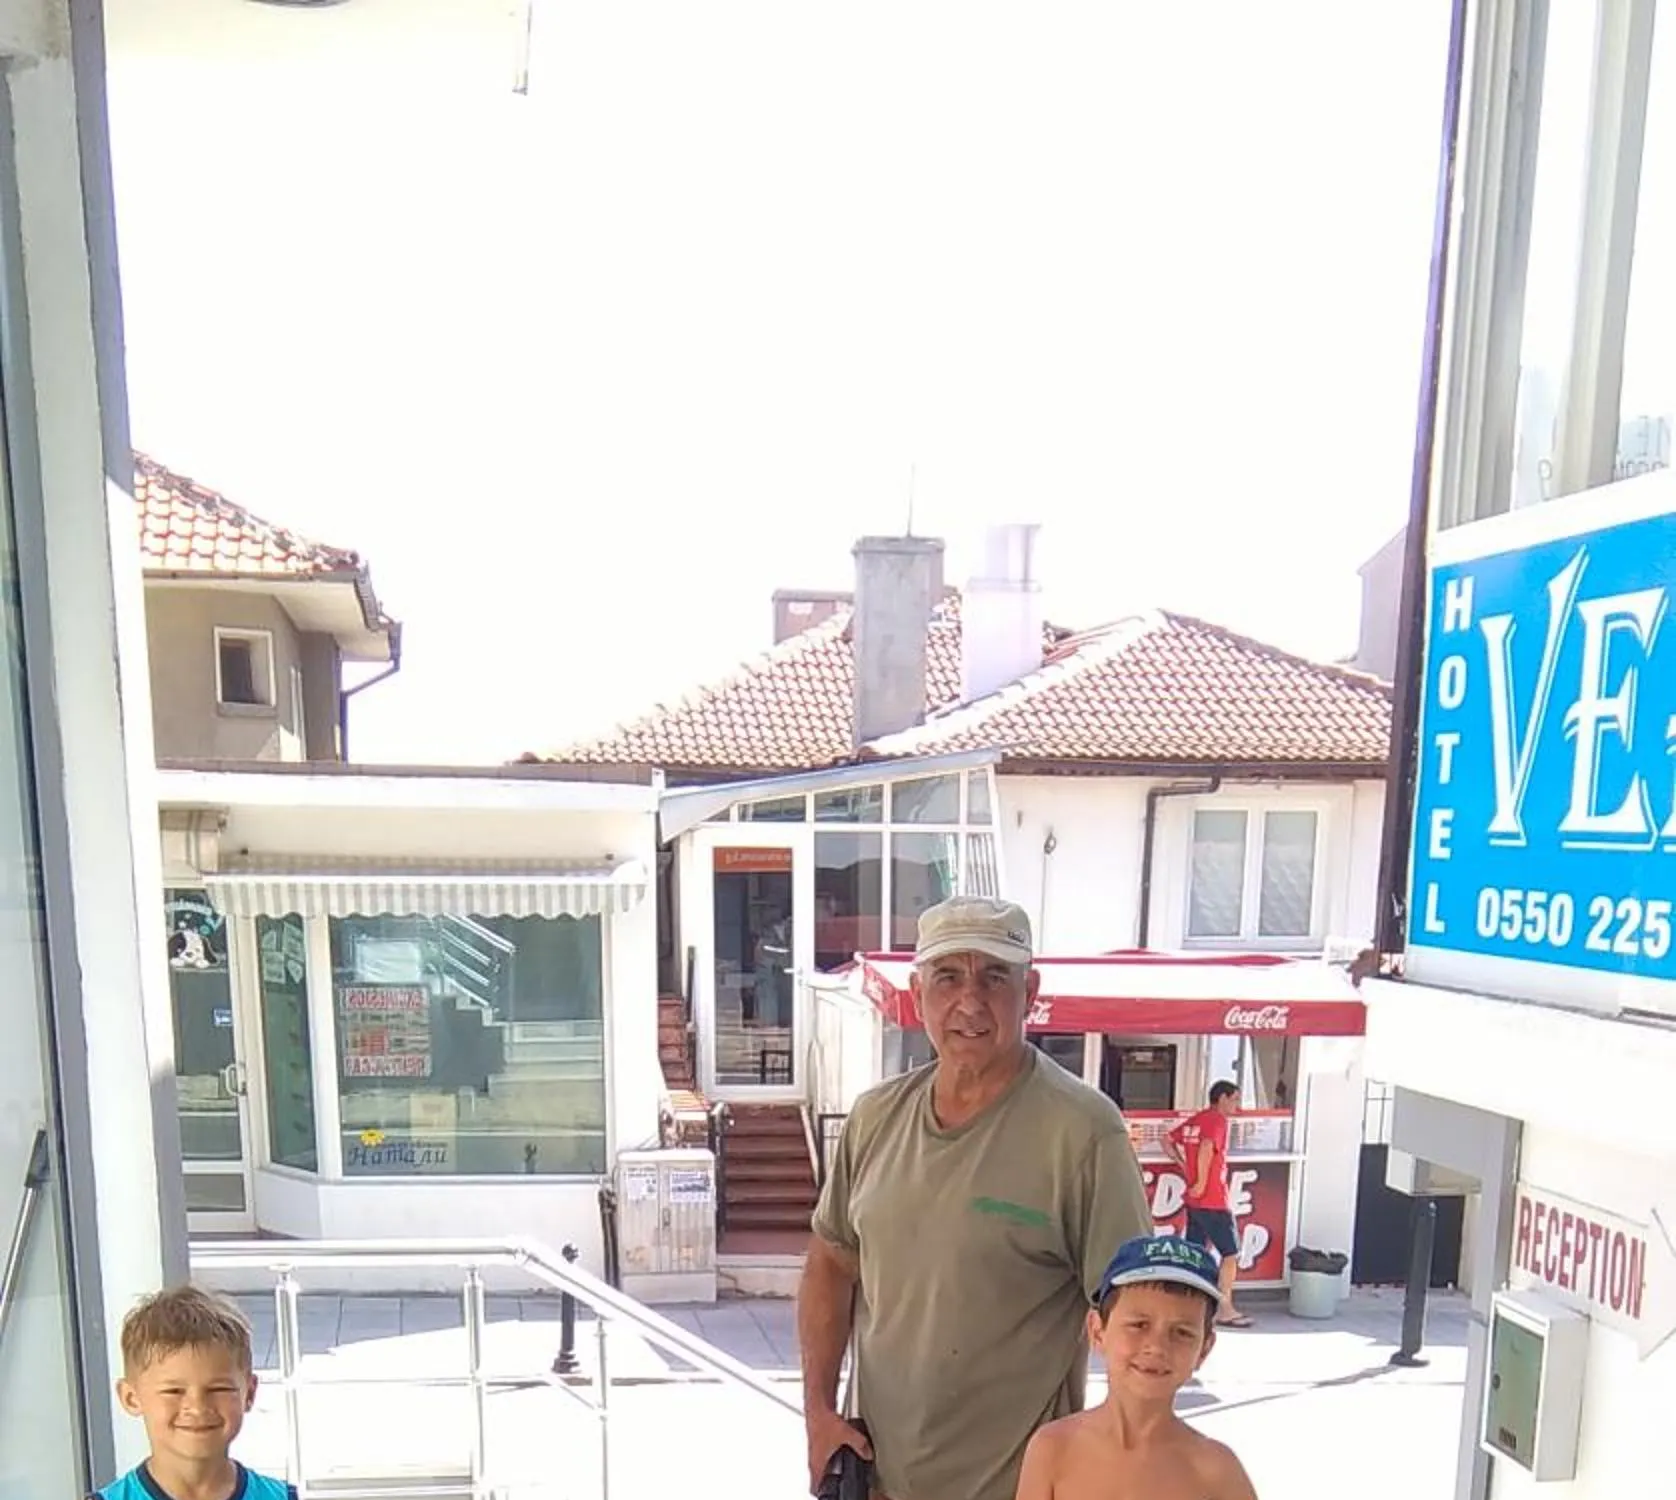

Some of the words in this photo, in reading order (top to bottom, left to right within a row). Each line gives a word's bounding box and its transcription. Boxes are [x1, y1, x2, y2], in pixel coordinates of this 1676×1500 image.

[1424, 576, 1475, 934] HOTEL
[1480, 543, 1676, 853] VE
[1476, 887, 1575, 948] 0550
[1584, 895, 1672, 959] 225
[1515, 1196, 1648, 1320] RECEPTION
